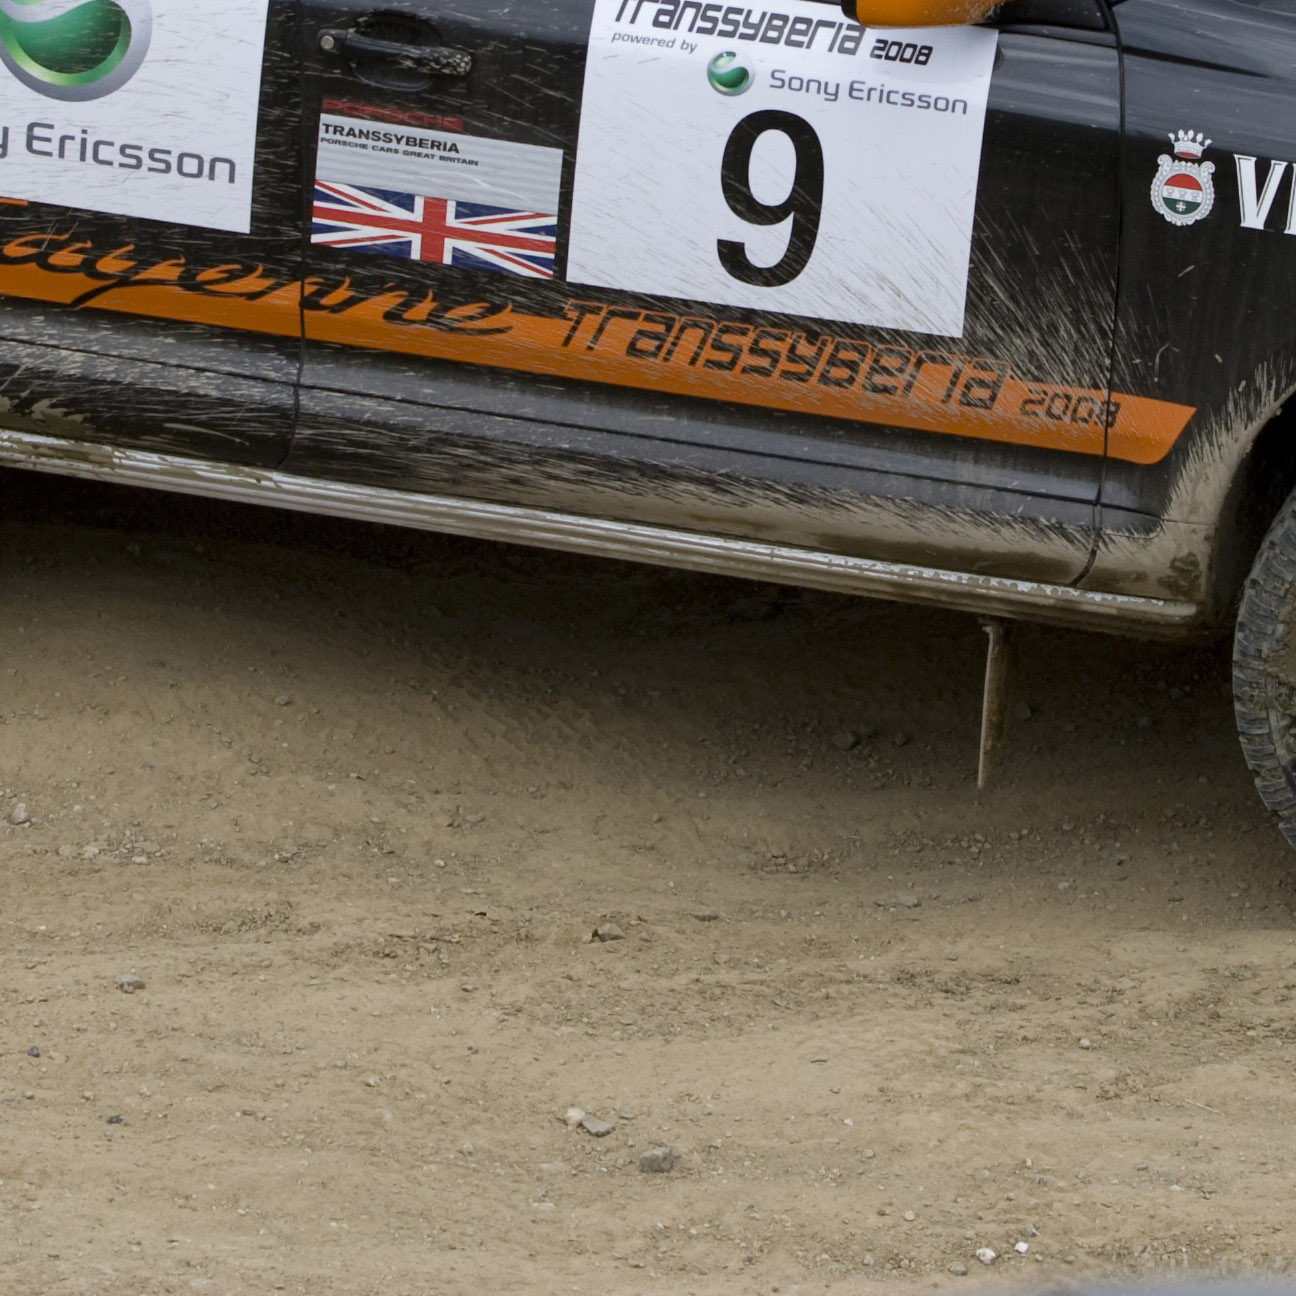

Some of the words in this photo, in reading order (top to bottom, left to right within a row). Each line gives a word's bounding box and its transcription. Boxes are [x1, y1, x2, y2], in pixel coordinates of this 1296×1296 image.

[611, 31, 676, 51] powered
[680, 39, 698, 55] by
[870, 38, 934, 66] 2008
[769, 68, 839, 102] Sony
[848, 80, 969, 115] Ericsson
[322, 98, 464, 132] PORSCHE
[25, 121, 237, 185] Ericsson
[320, 137, 368, 150] PORSCHE
[372, 145, 399, 155] CARS
[402, 149, 436, 160] GREAT
[439, 154, 479, 166] BRITAIN
[321, 122, 460, 153] TRANSSYBERIA
[715, 109, 826, 289] 9
[1019, 388, 1121, 428] 2008
